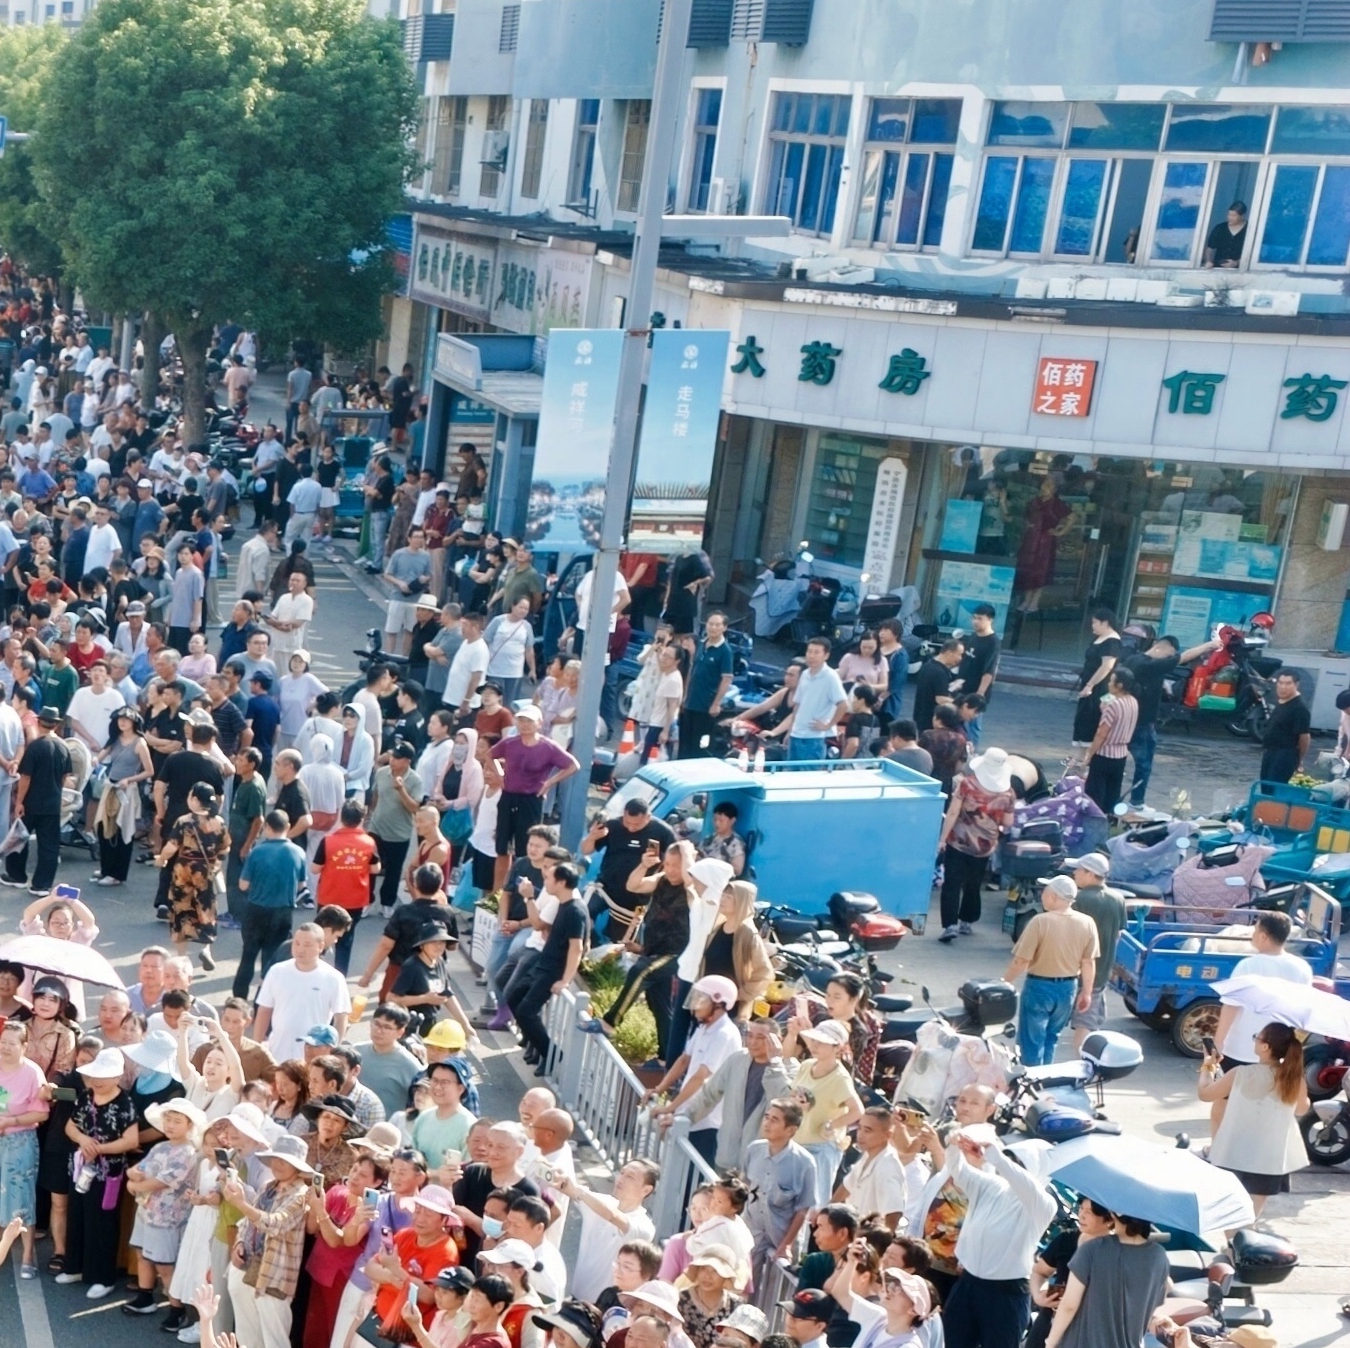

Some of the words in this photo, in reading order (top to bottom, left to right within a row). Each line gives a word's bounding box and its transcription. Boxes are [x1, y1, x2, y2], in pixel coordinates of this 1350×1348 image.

[731, 336, 931, 396] 大药房
[1043, 362, 1087, 388] 佰药
[672, 385, 694, 438] 走马楼
[1036, 392, 1082, 416] 之家
[1163, 370, 1349, 422] 佰药
